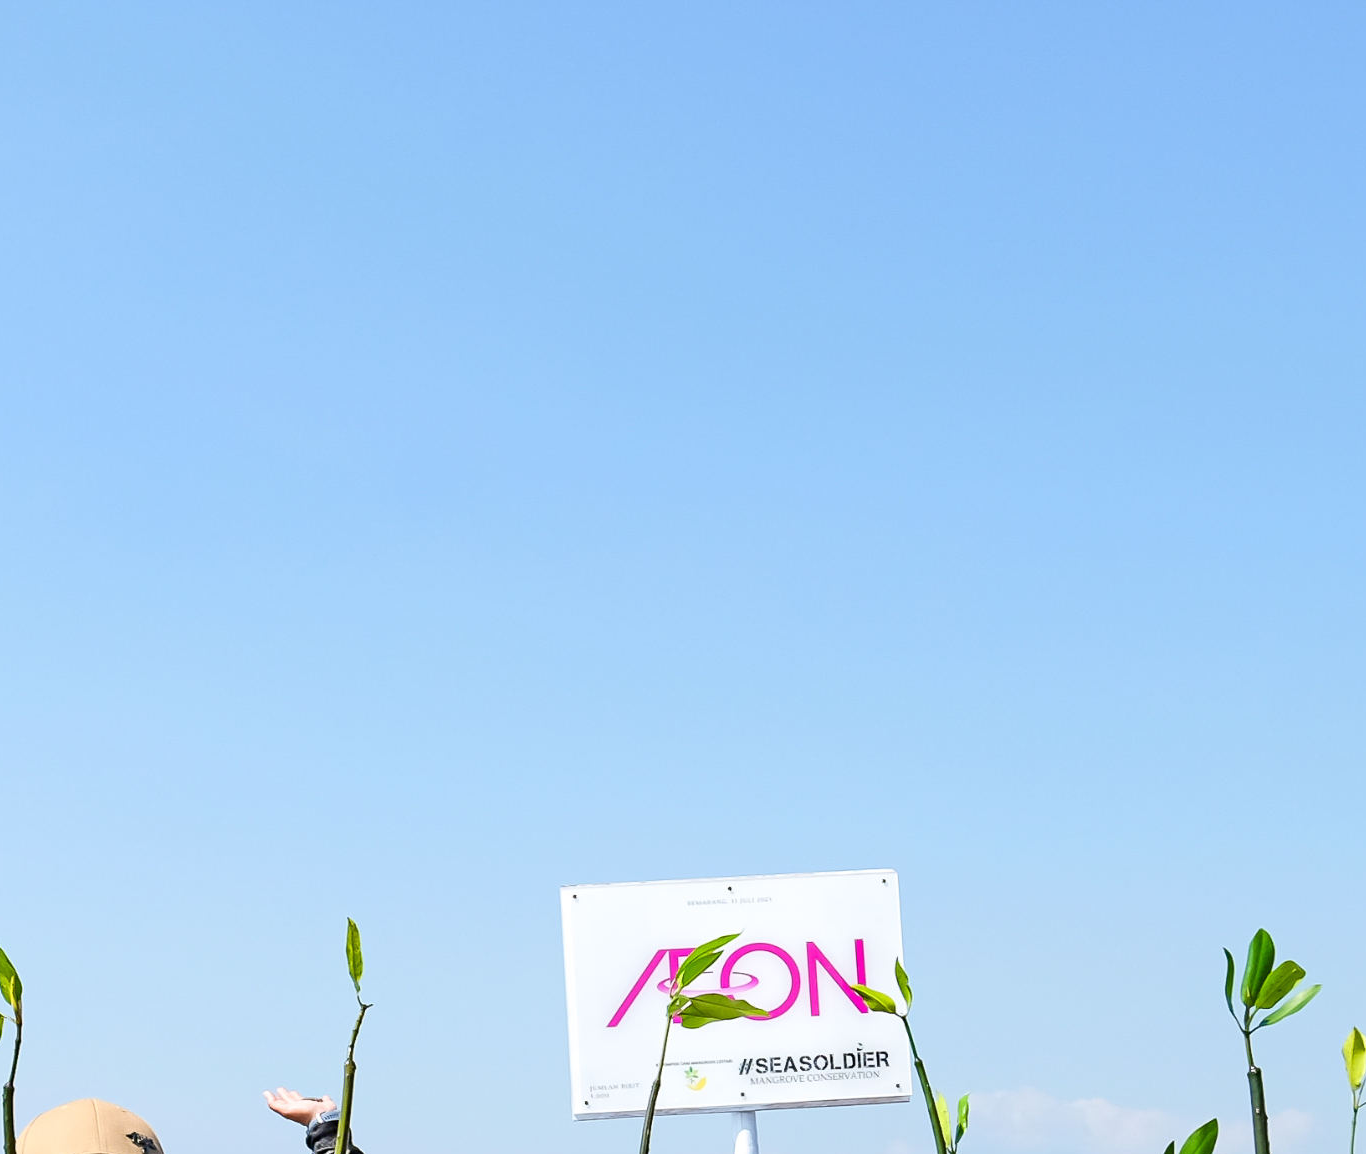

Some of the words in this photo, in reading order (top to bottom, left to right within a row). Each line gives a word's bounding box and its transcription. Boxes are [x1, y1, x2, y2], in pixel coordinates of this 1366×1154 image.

[738, 1042, 890, 1075] #SEASOLDIER
[750, 1074, 805, 1085] MANGROVE
[806, 1070, 881, 1083] CONSERVATION
